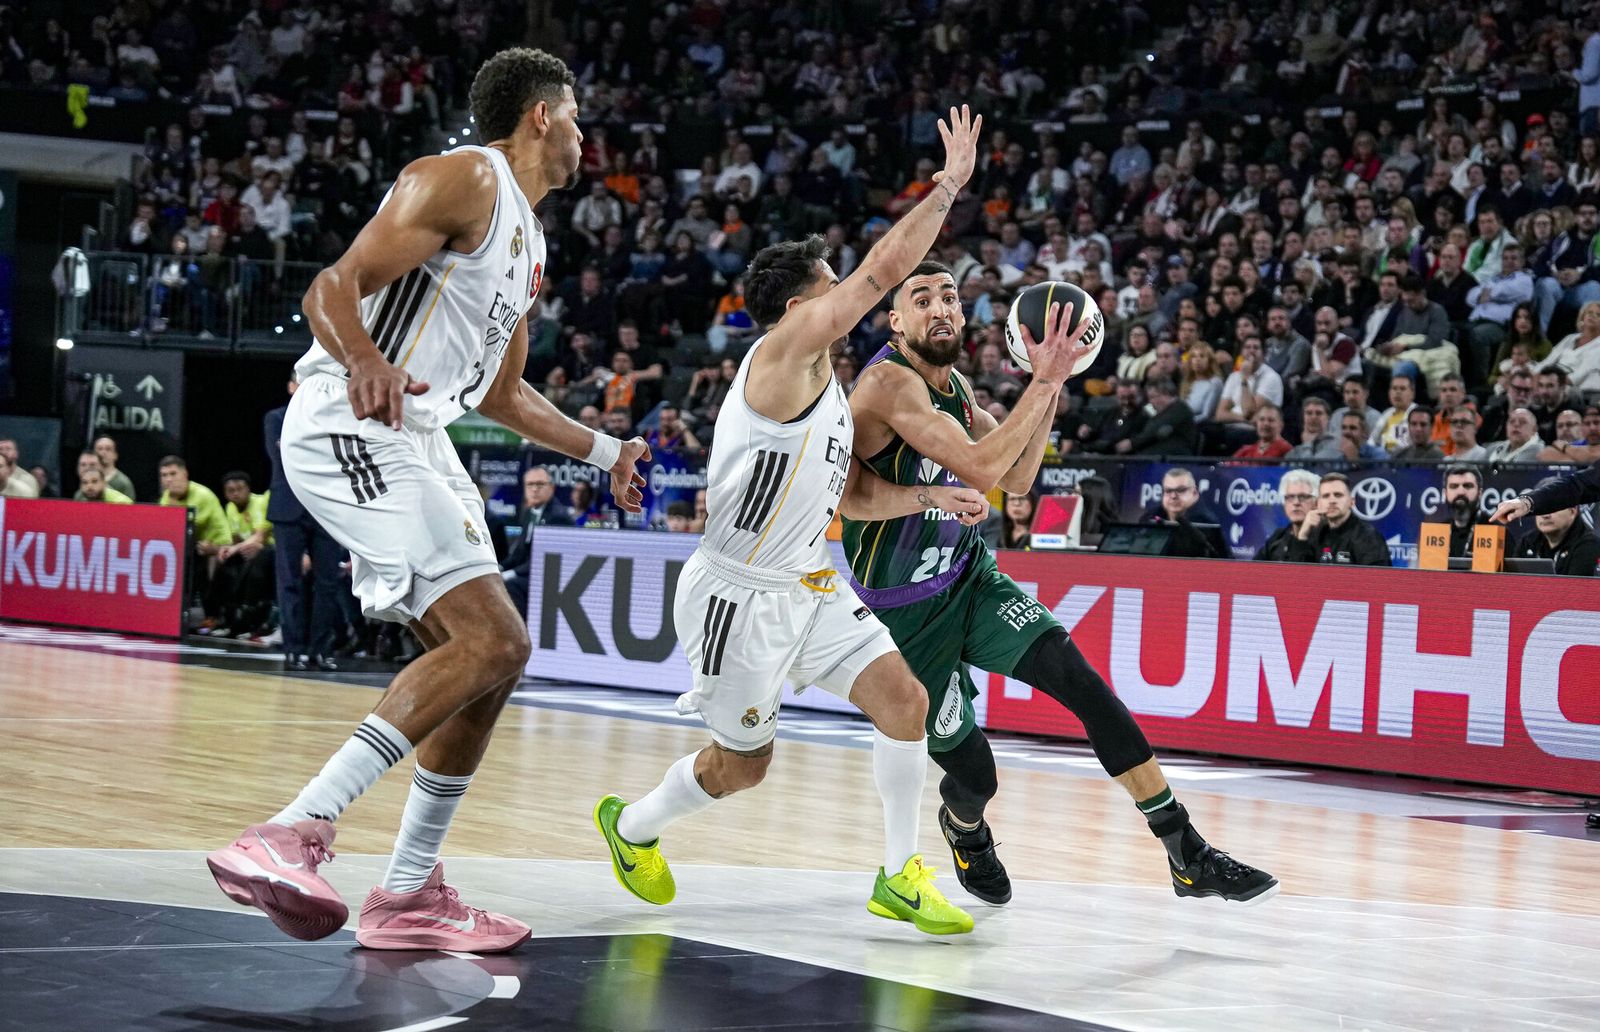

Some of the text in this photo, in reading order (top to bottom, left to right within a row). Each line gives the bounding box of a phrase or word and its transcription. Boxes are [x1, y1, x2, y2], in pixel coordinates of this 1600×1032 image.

[95, 404, 165, 431] ALIDA
[1426, 535, 1445, 547] IRS
[1476, 537, 1492, 549] IRS
[4, 530, 177, 600] KUMHO
[996, 596, 1018, 617] sabor
[1007, 605, 1045, 632] laga
